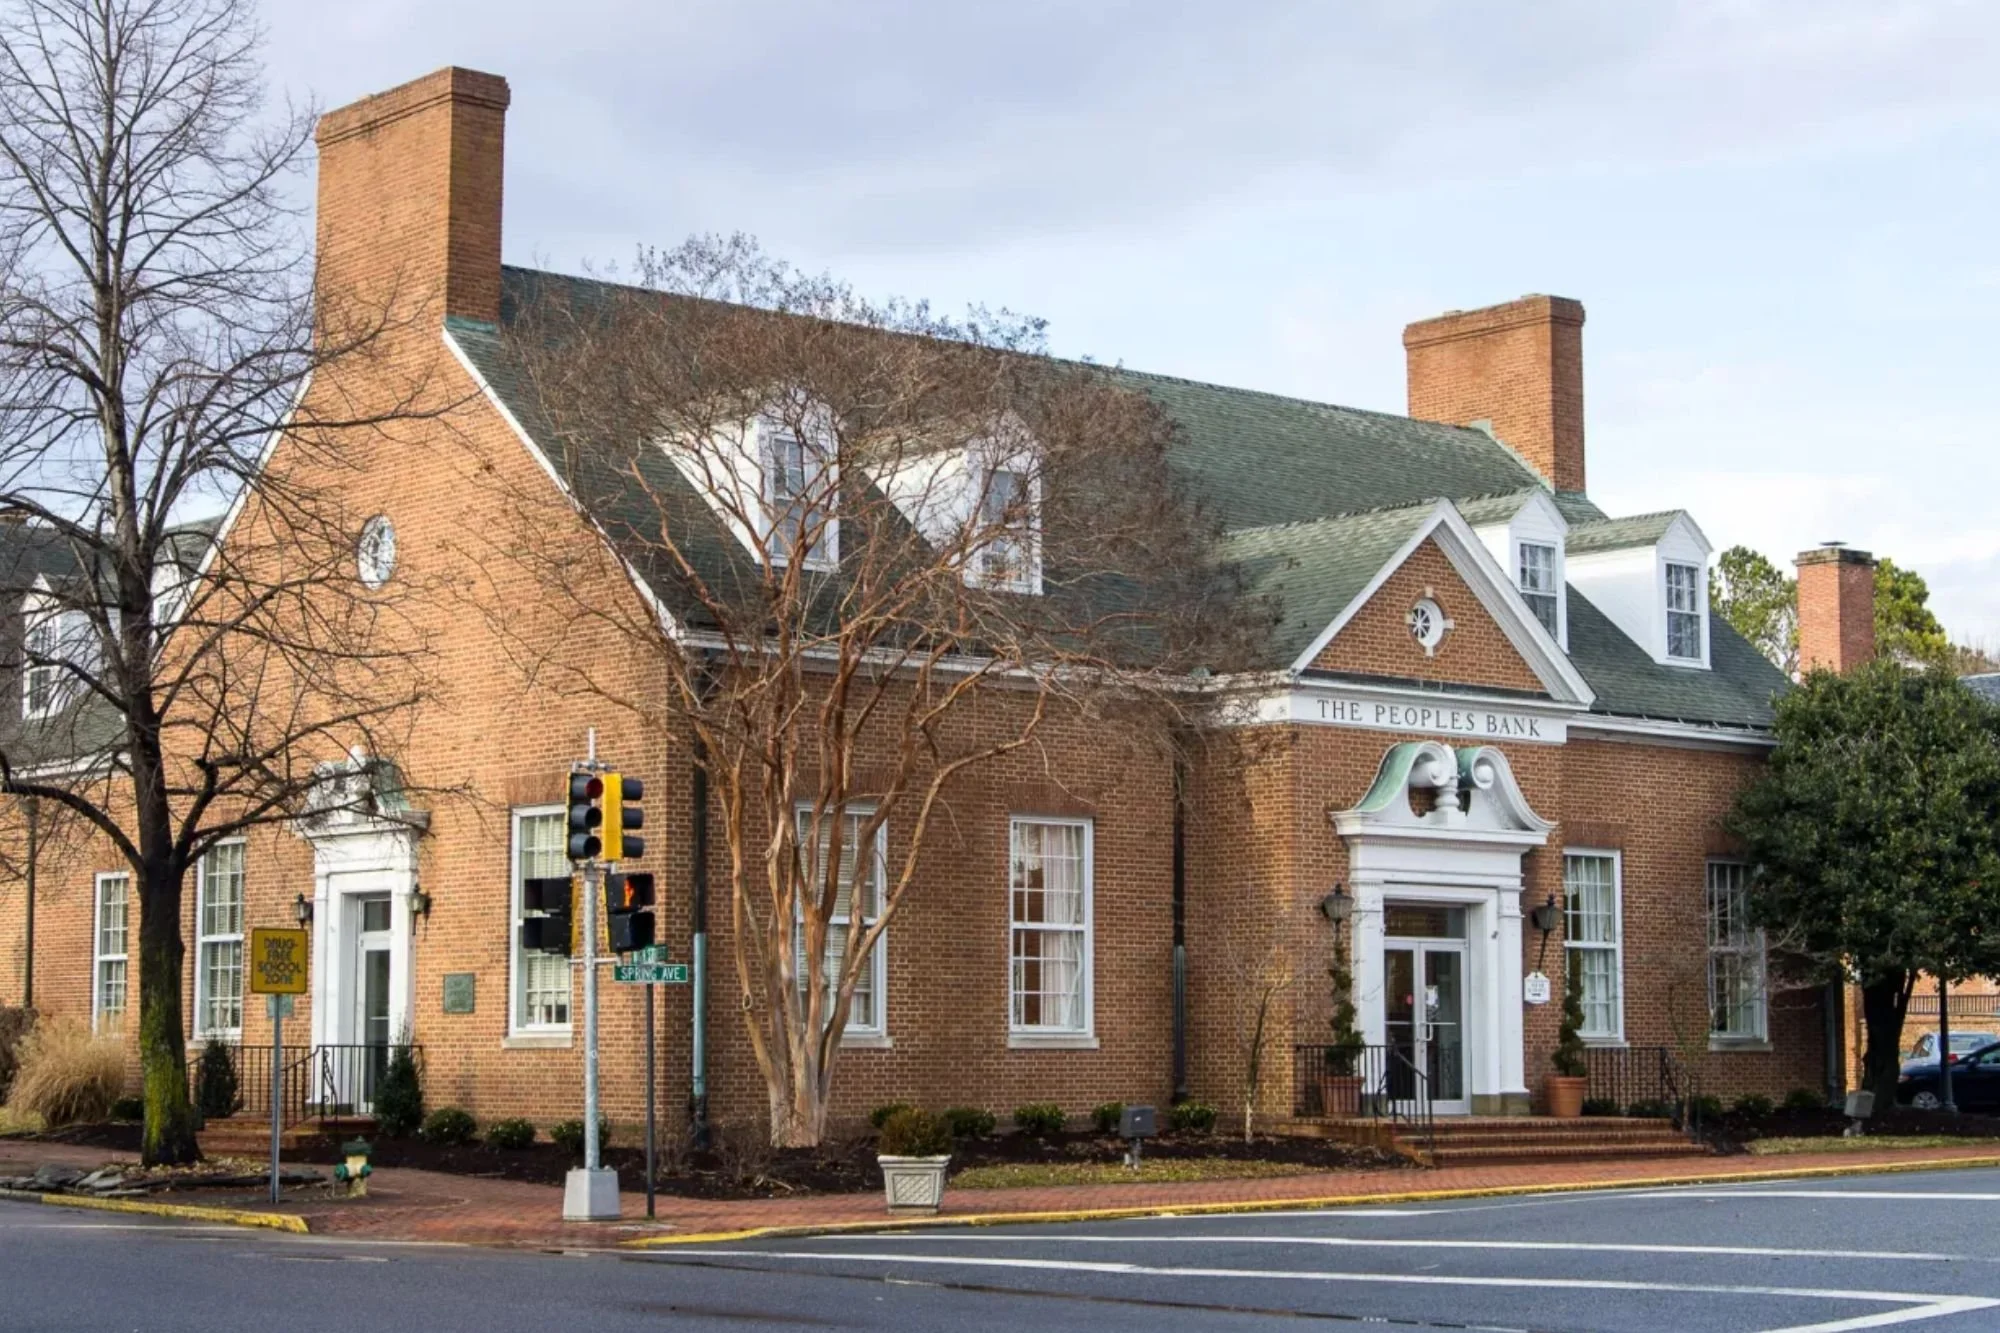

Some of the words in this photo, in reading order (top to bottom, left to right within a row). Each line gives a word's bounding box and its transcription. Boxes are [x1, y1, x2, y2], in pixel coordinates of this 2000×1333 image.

[1316, 699, 1363, 722] THE
[1374, 704, 1475, 731] PEOPLES
[1486, 714, 1541, 738] BANK
[256, 961, 302, 973] SCHOOL
[264, 973, 294, 985] ZONE
[620, 967, 657, 980] SPRING
[662, 967, 681, 980] AVE
